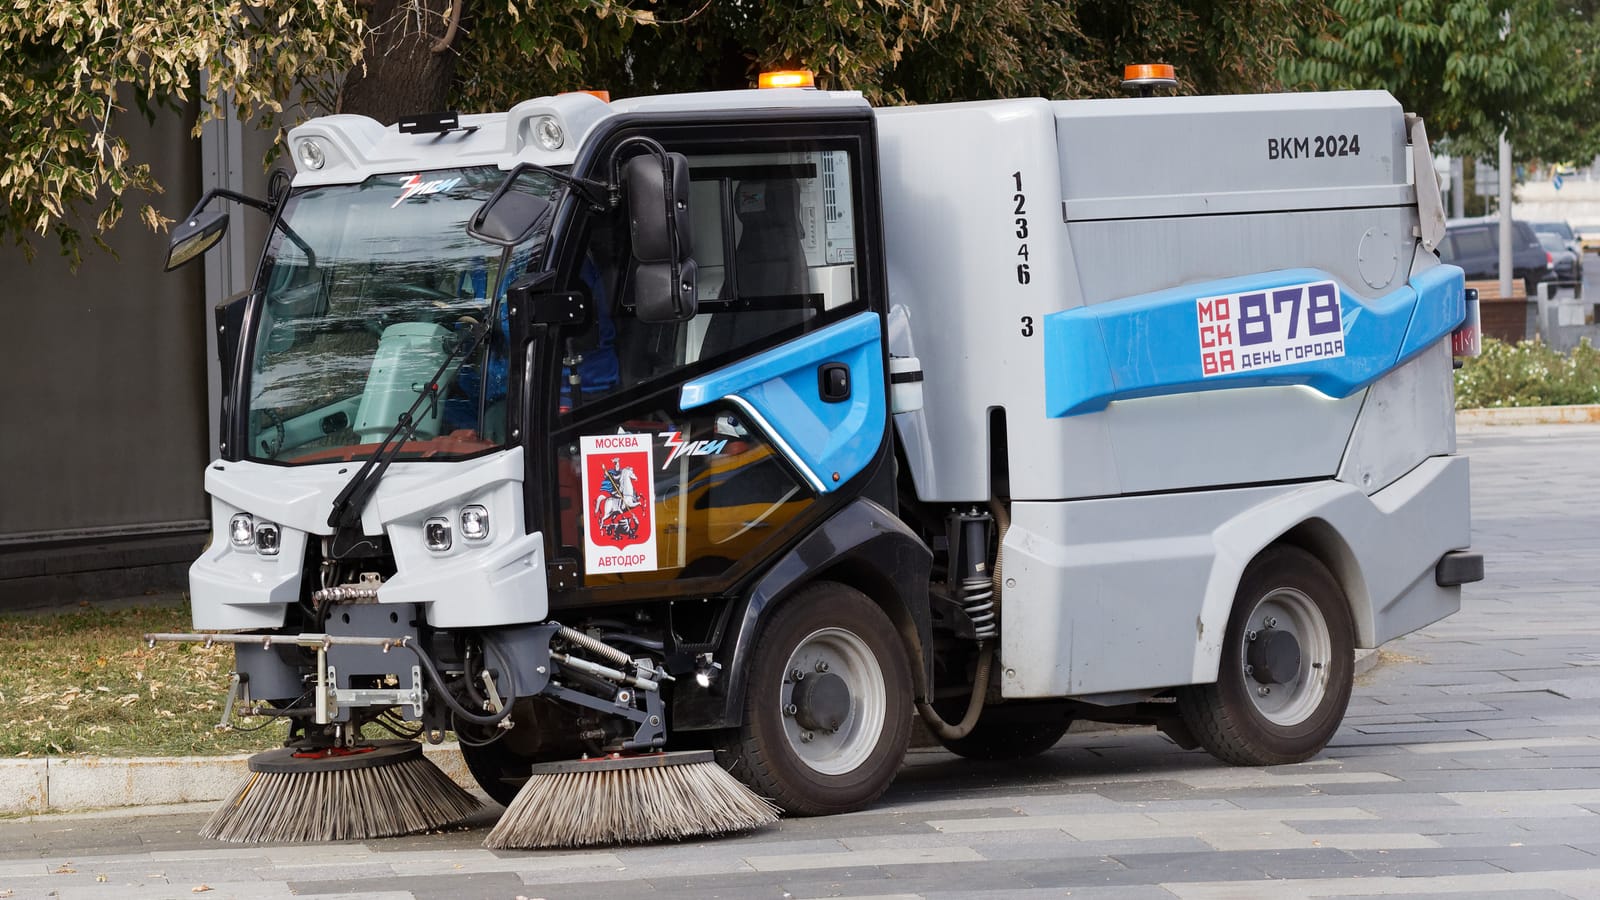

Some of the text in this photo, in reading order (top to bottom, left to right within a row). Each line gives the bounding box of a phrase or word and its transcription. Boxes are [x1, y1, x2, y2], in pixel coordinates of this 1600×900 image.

[1314, 134, 1360, 158] 2024
[1238, 283, 1341, 347] 878
[1241, 340, 1344, 369] ДЕНЬ ГОРОДА
[595, 437, 639, 449] МОСКВА
[598, 554, 646, 567] АВТОДОР
